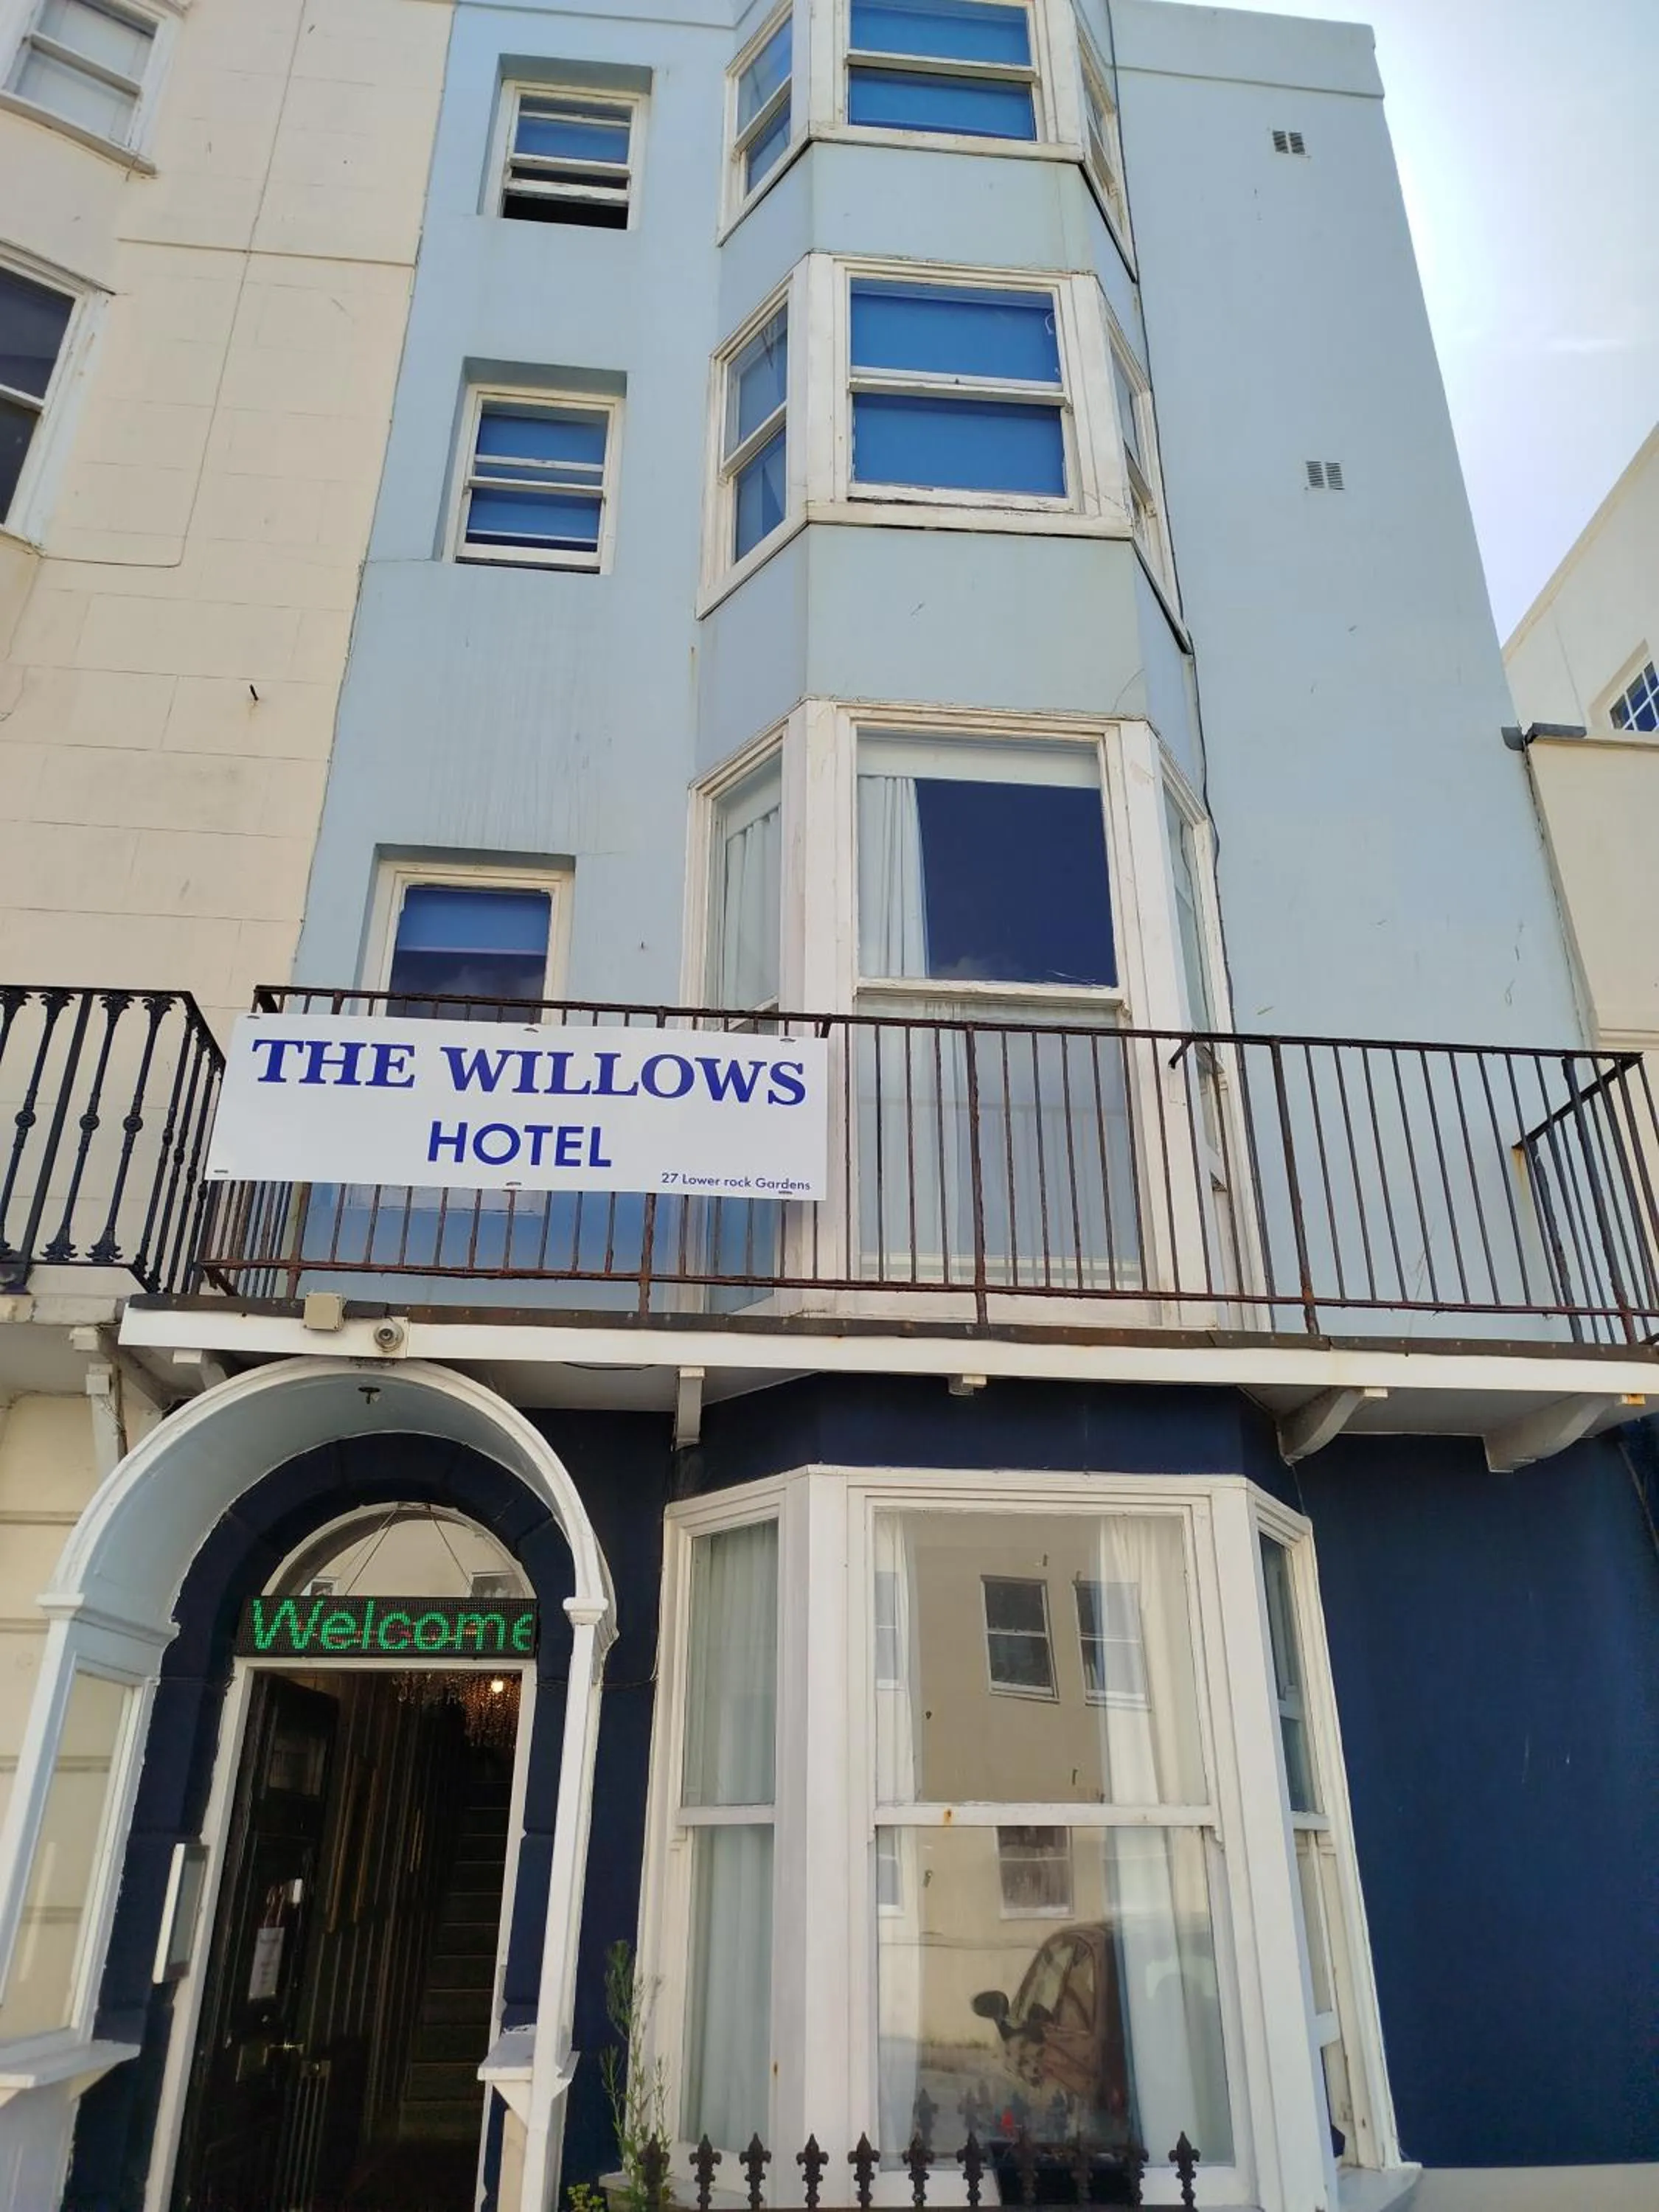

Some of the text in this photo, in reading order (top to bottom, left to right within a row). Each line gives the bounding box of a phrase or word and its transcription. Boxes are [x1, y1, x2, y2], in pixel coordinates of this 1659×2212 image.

[252, 1040, 806, 1105] THE WILLOWS
[428, 1121, 611, 1167] HOTEL
[661, 1173, 810, 1191] 27 Lower rock Gardens
